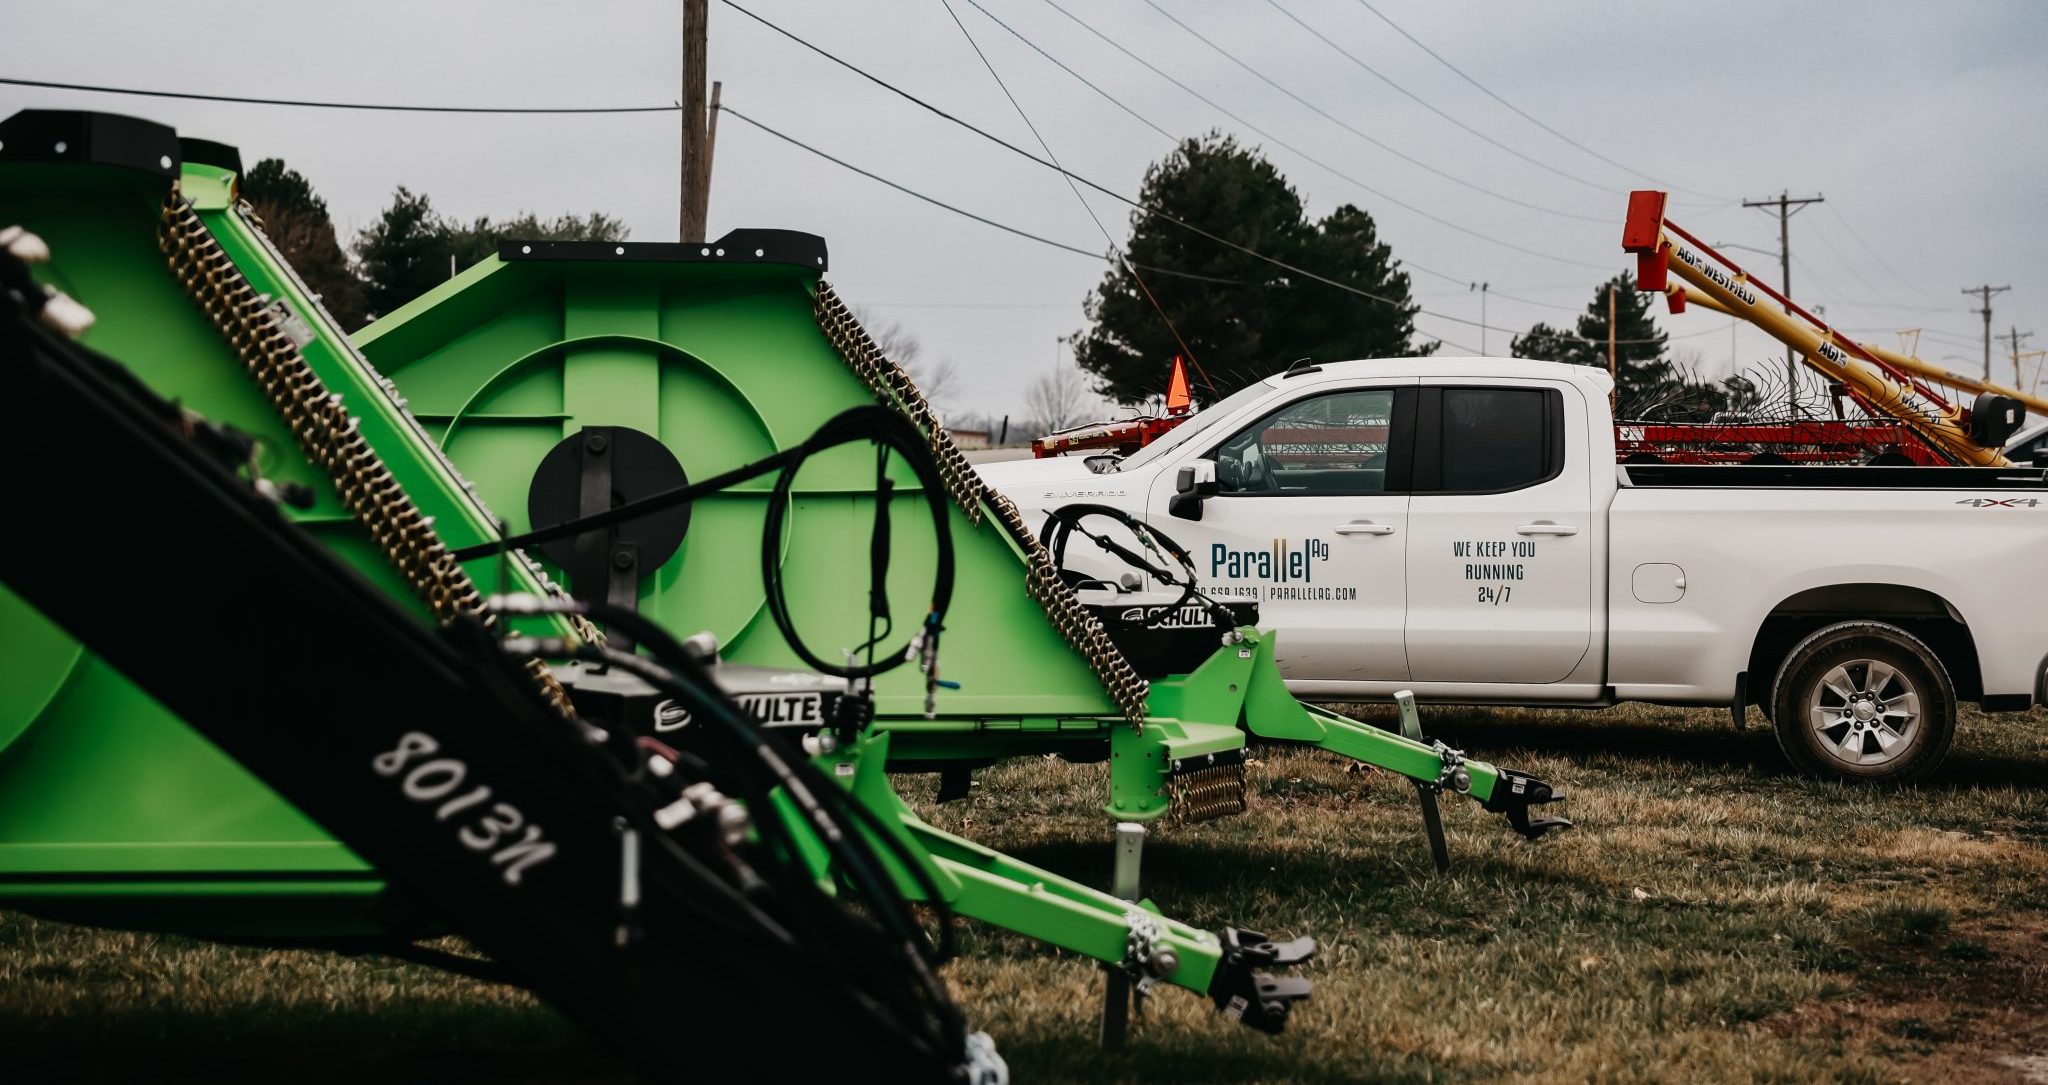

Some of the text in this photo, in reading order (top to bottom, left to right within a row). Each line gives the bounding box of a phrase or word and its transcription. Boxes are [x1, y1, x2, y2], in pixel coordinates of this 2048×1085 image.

[1676, 246, 1756, 306] AGI WESTFIELD
[1817, 341, 1839, 362] AGI
[1043, 490, 1127, 499] SILVERADO
[1453, 541, 1536, 558] WE KEEP YOU
[1211, 538, 1329, 583] Parallel Ag
[1465, 564, 1524, 581] RUNNING
[1270, 587, 1357, 601] PARALLELAG.COM
[1478, 584, 1511, 606] 24/7
